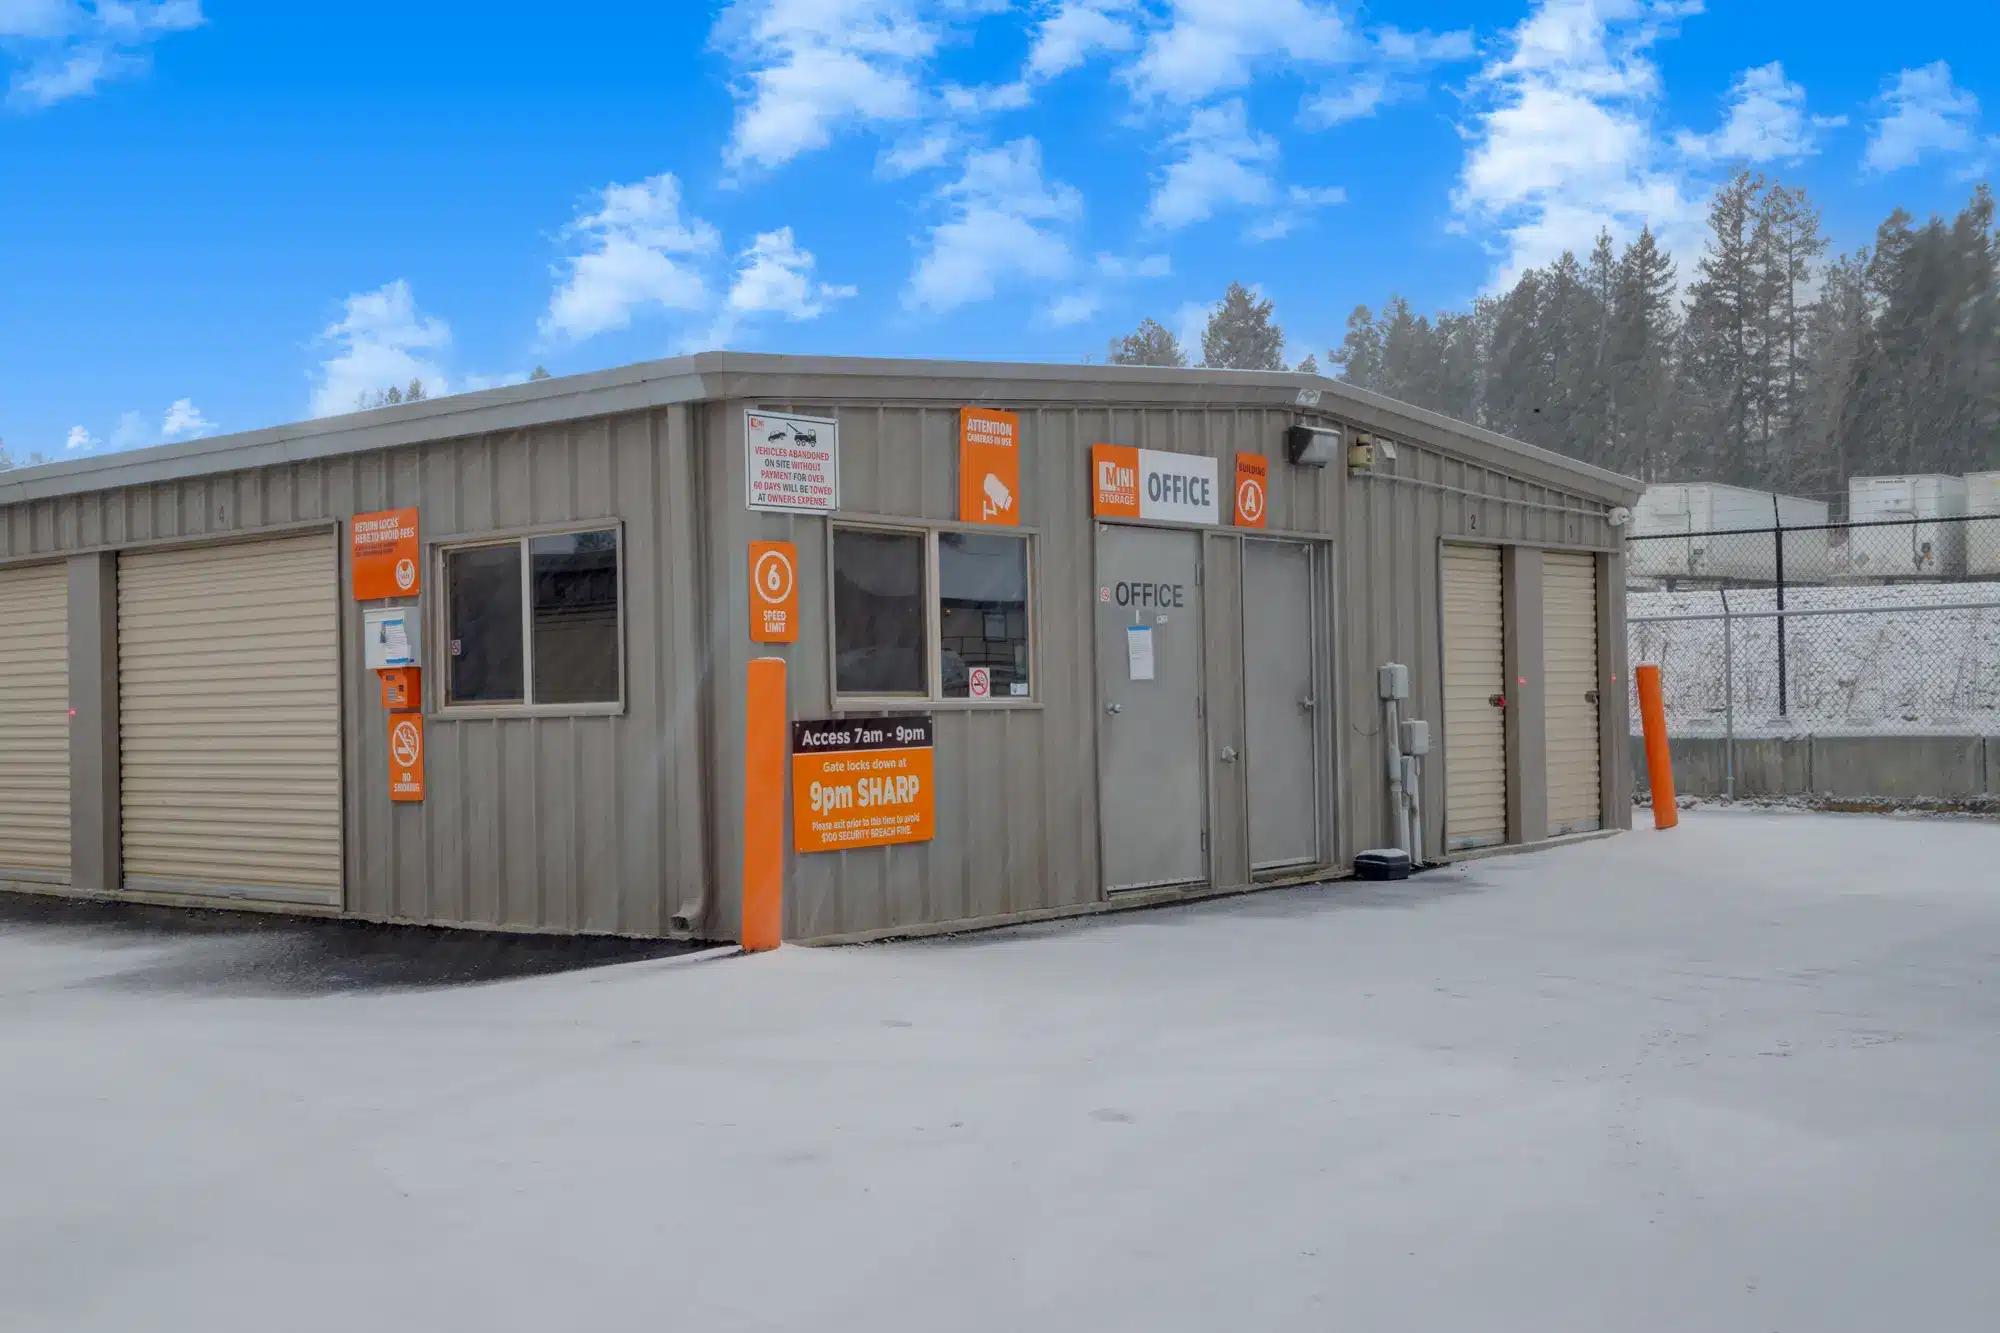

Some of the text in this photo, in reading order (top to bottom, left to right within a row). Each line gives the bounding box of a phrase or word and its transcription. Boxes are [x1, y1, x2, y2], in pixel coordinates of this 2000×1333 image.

[967, 419, 1012, 436] ATTENTION
[1001, 438, 1012, 447] USE
[755, 446, 829, 461] VEHICLES ABANDONED
[764, 458, 821, 472] ON SITE WITHOUT
[1239, 463, 1266, 477] BUILDING
[761, 470, 825, 484] PAYMENT FOR OVER
[1101, 463, 1134, 489] MINI
[764, 481, 781, 491] DAYS
[783, 483, 798, 493] WILL
[800, 484, 809, 494] BE
[809, 485, 833, 496] TOWED
[1147, 471, 1211, 507] OFFICE
[757, 493, 766, 502] AT
[767, 493, 796, 504] OWNERS
[1099, 493, 1136, 506] STORAGE
[1245, 486, 1257, 512] A
[355, 521, 378, 533] RETURN
[1470, 514, 1476, 530] 2
[380, 529, 400, 541] AVOID
[400, 527, 414, 539] FEES
[767, 563, 781, 591] 6
[1115, 581, 1184, 608] OFFICE
[763, 610, 786, 621] SPEED
[764, 622, 786, 633] LIMIT
[802, 730, 851, 747] Access
[854, 727, 883, 744] 7am
[896, 725, 925, 743] 9pm
[823, 757, 907, 773] Gate locks down at
[402, 772, 411, 783] NO
[394, 783, 420, 793] SMOKING
[809, 775, 920, 816] 9pm SHARP
[811, 821, 833, 832] Please
[833, 819, 846, 829] exit
[862, 818, 870, 827] to
[882, 815, 896, 825] time
[896, 815, 903, 825] to
[838, 829, 870, 841] SECURITY
[870, 826, 896, 839] BREACH
